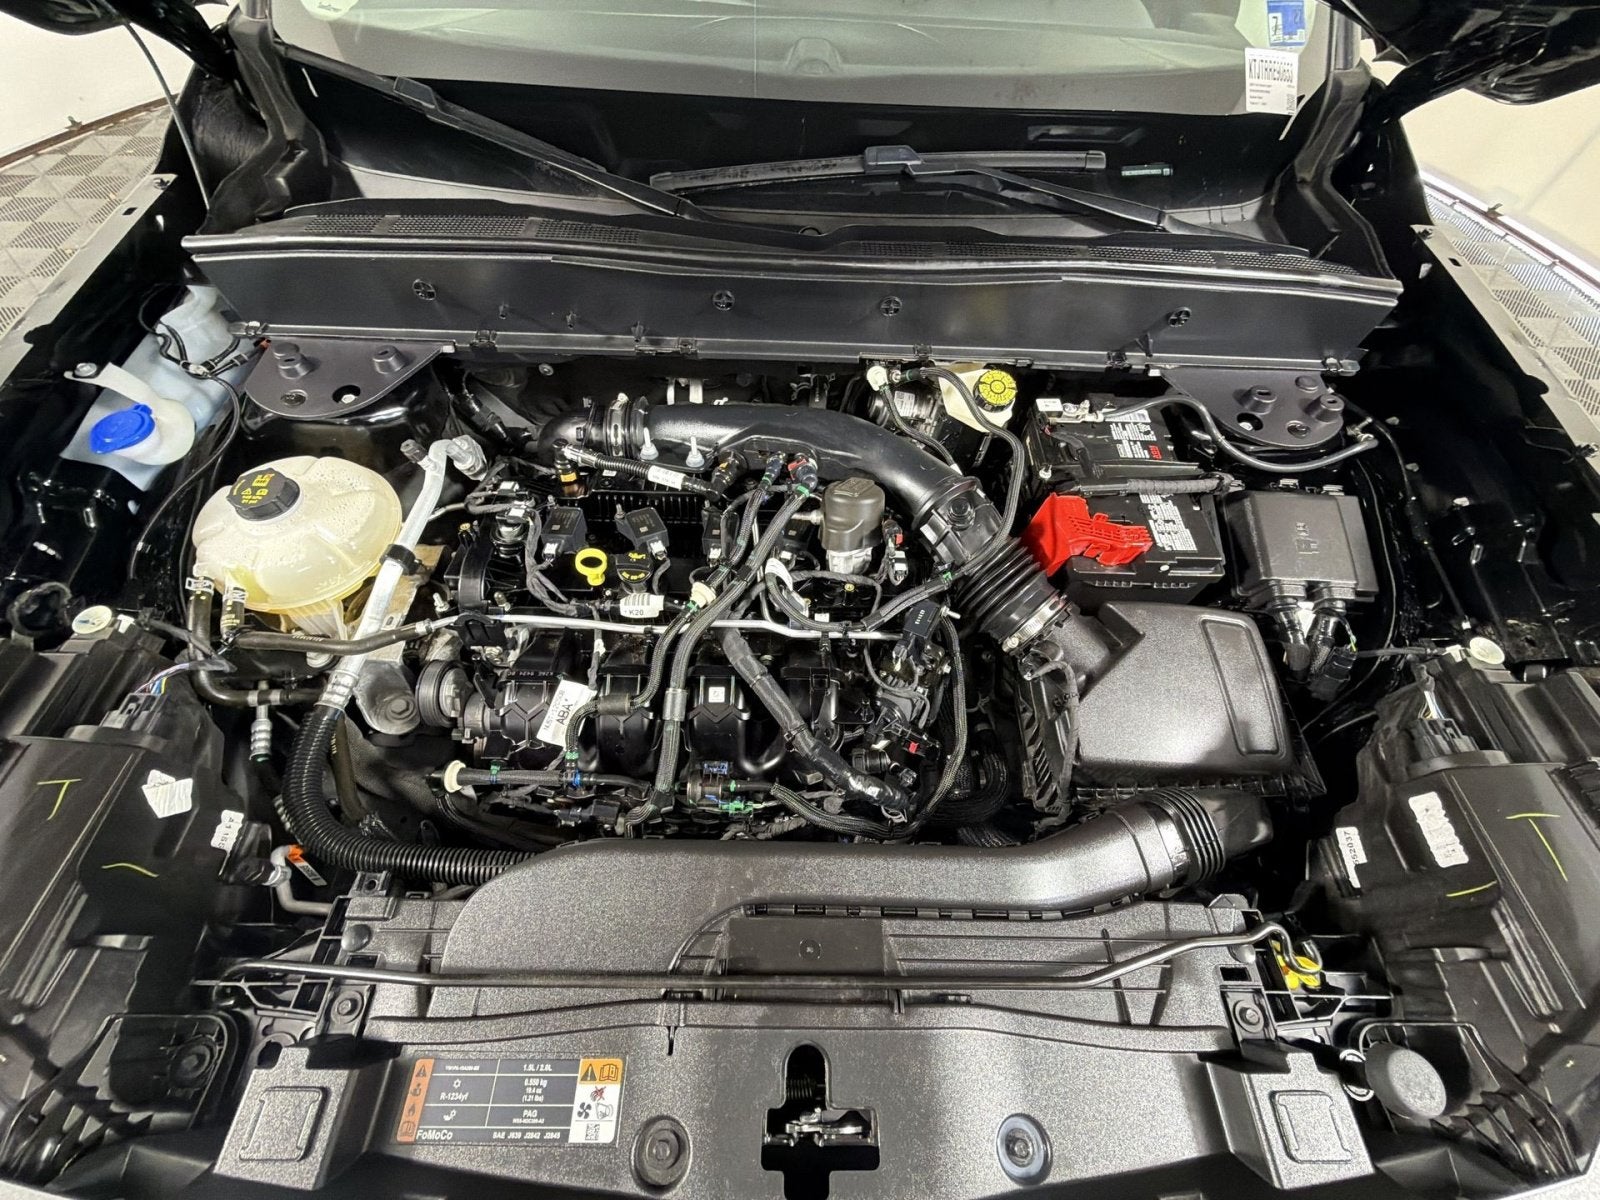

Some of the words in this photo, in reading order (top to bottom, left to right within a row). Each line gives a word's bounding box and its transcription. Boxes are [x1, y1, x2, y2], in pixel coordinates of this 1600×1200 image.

[556, 703, 574, 726] ABA
[440, 1092, 469, 1103] R-1234yf
[522, 1109, 538, 1118] PAG
[416, 1129, 454, 1141] FoMoCo
